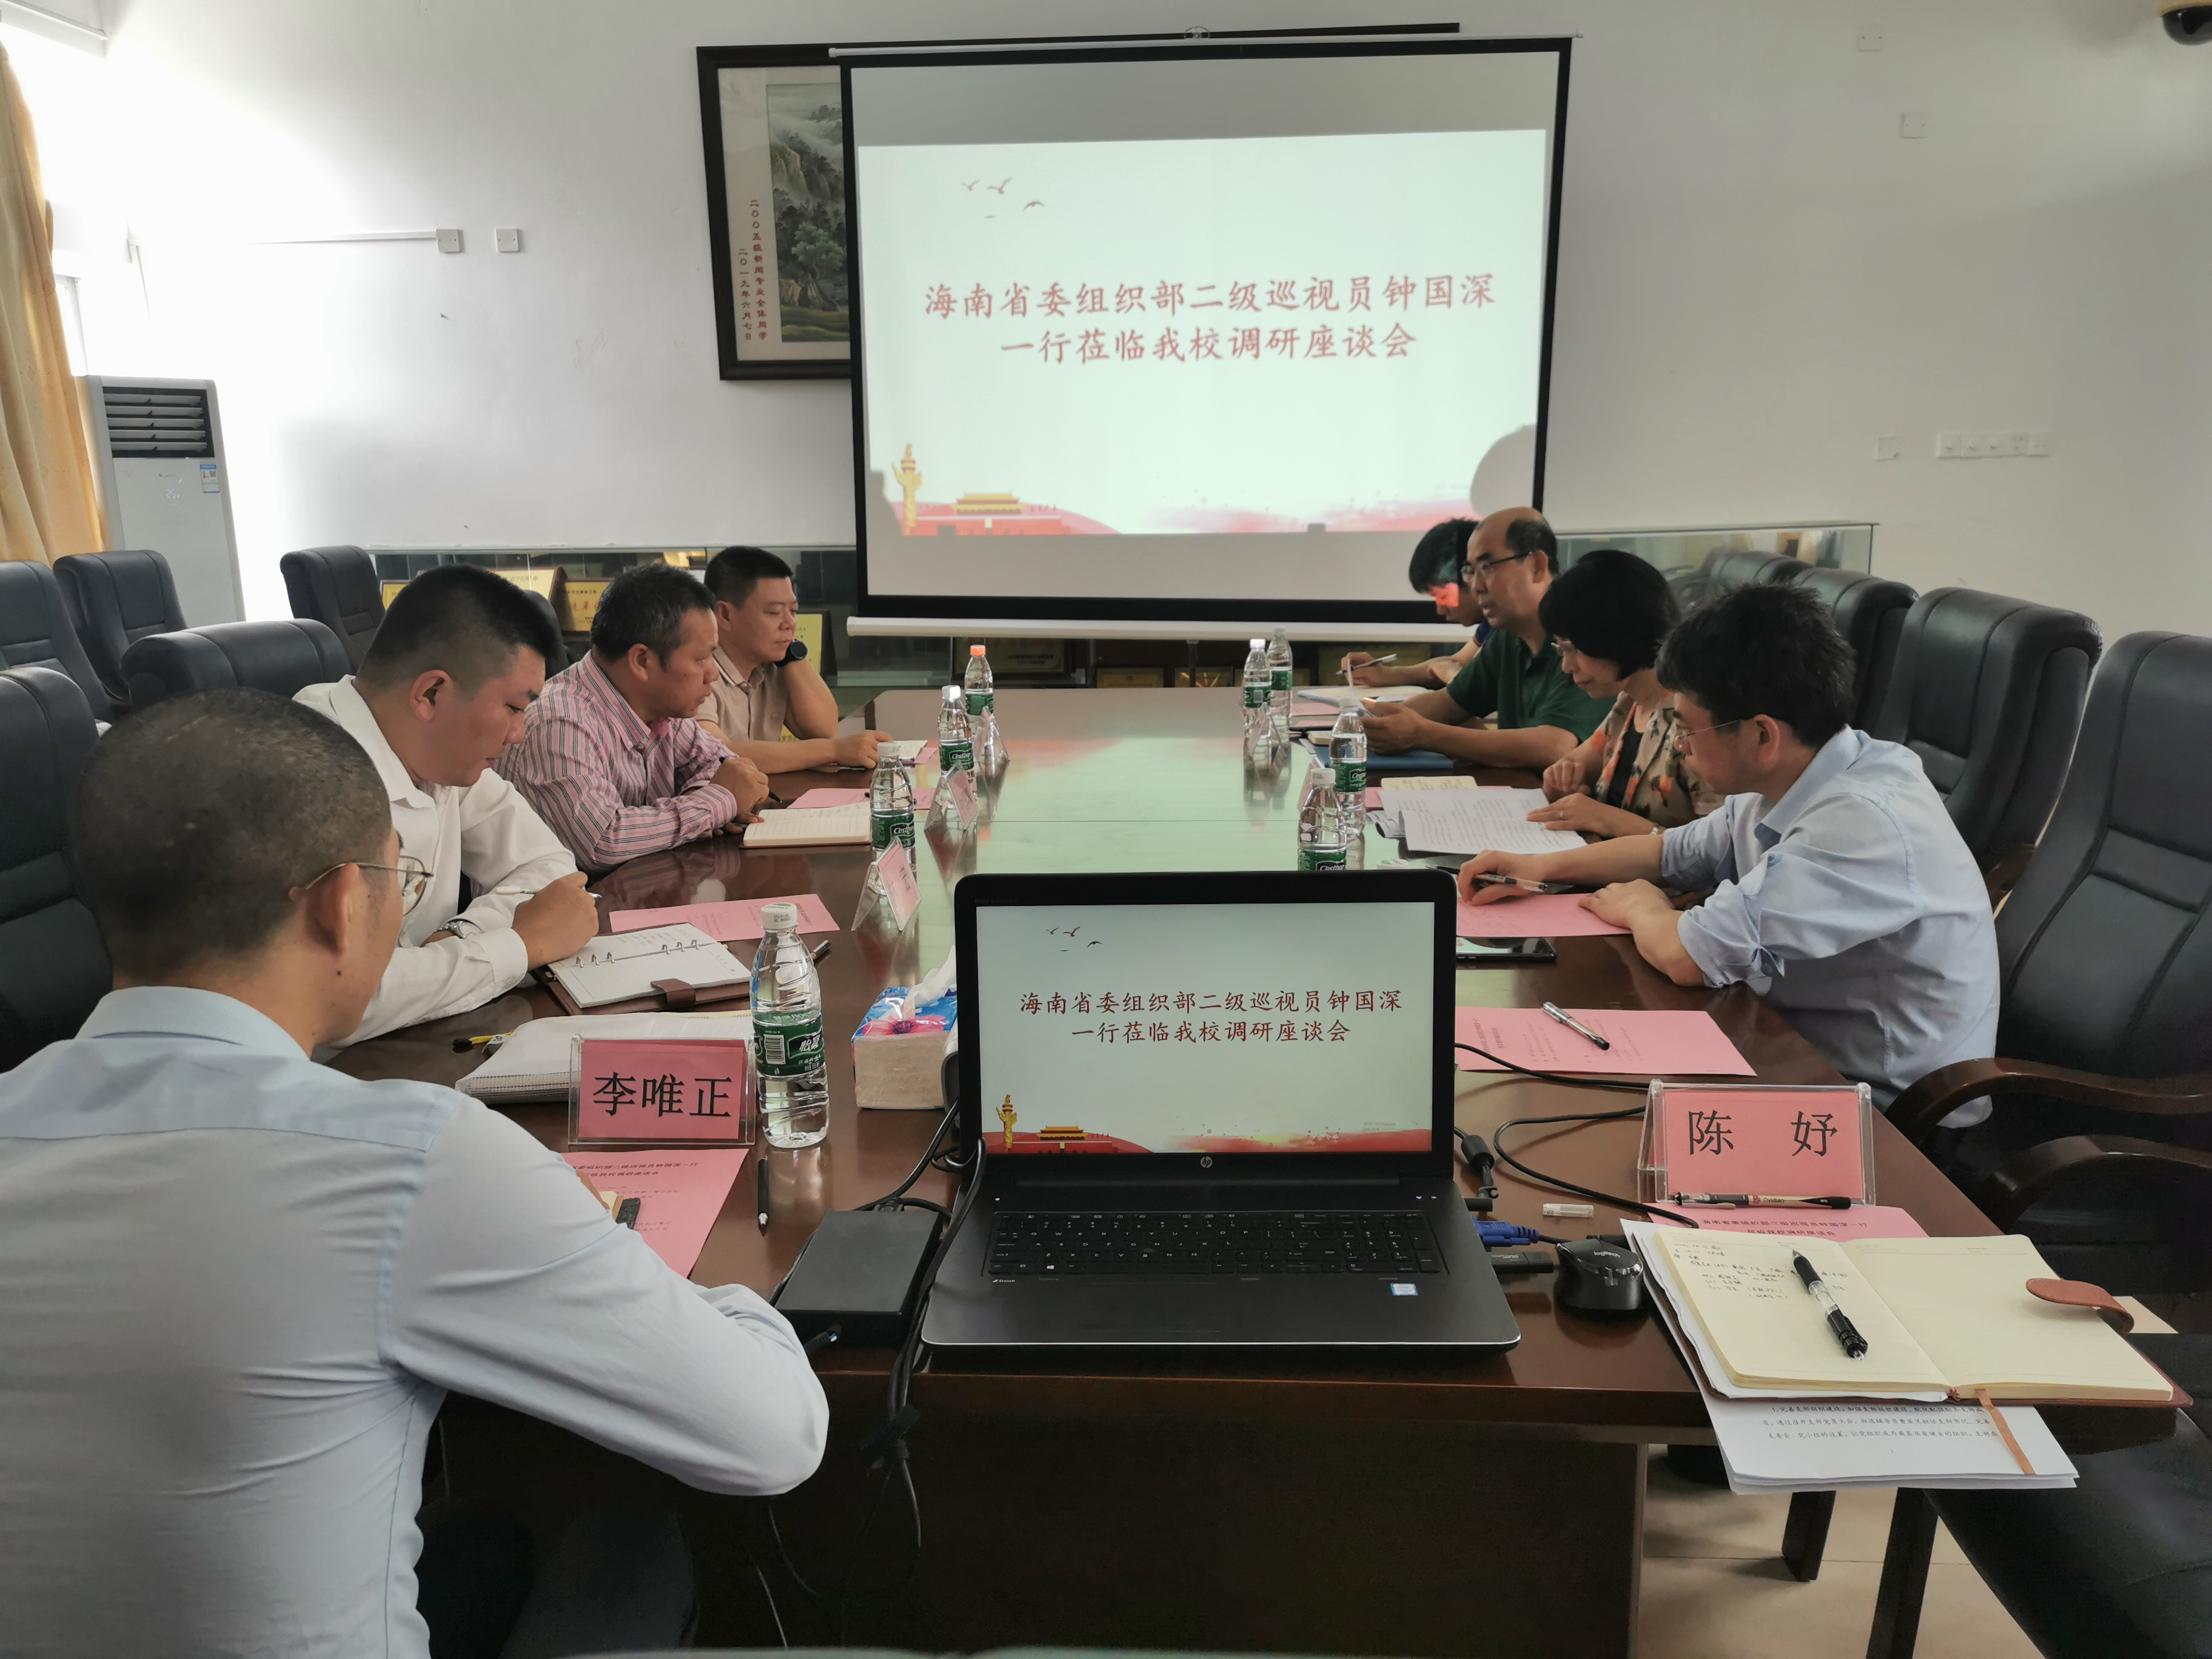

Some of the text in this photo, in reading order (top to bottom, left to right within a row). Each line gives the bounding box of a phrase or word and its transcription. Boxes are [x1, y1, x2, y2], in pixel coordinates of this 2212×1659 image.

[925, 273, 1496, 319] 海南省委组织部二级巡视员钟国深
[1000, 322, 1417, 364] 一行莅临我校调研座谈会
[1020, 990, 1403, 1014] 海南省委组织部二级巡视员钟国深
[1071, 1020, 1352, 1043] 一行莅临我校调研座谈会
[592, 1071, 732, 1118] 李唯正
